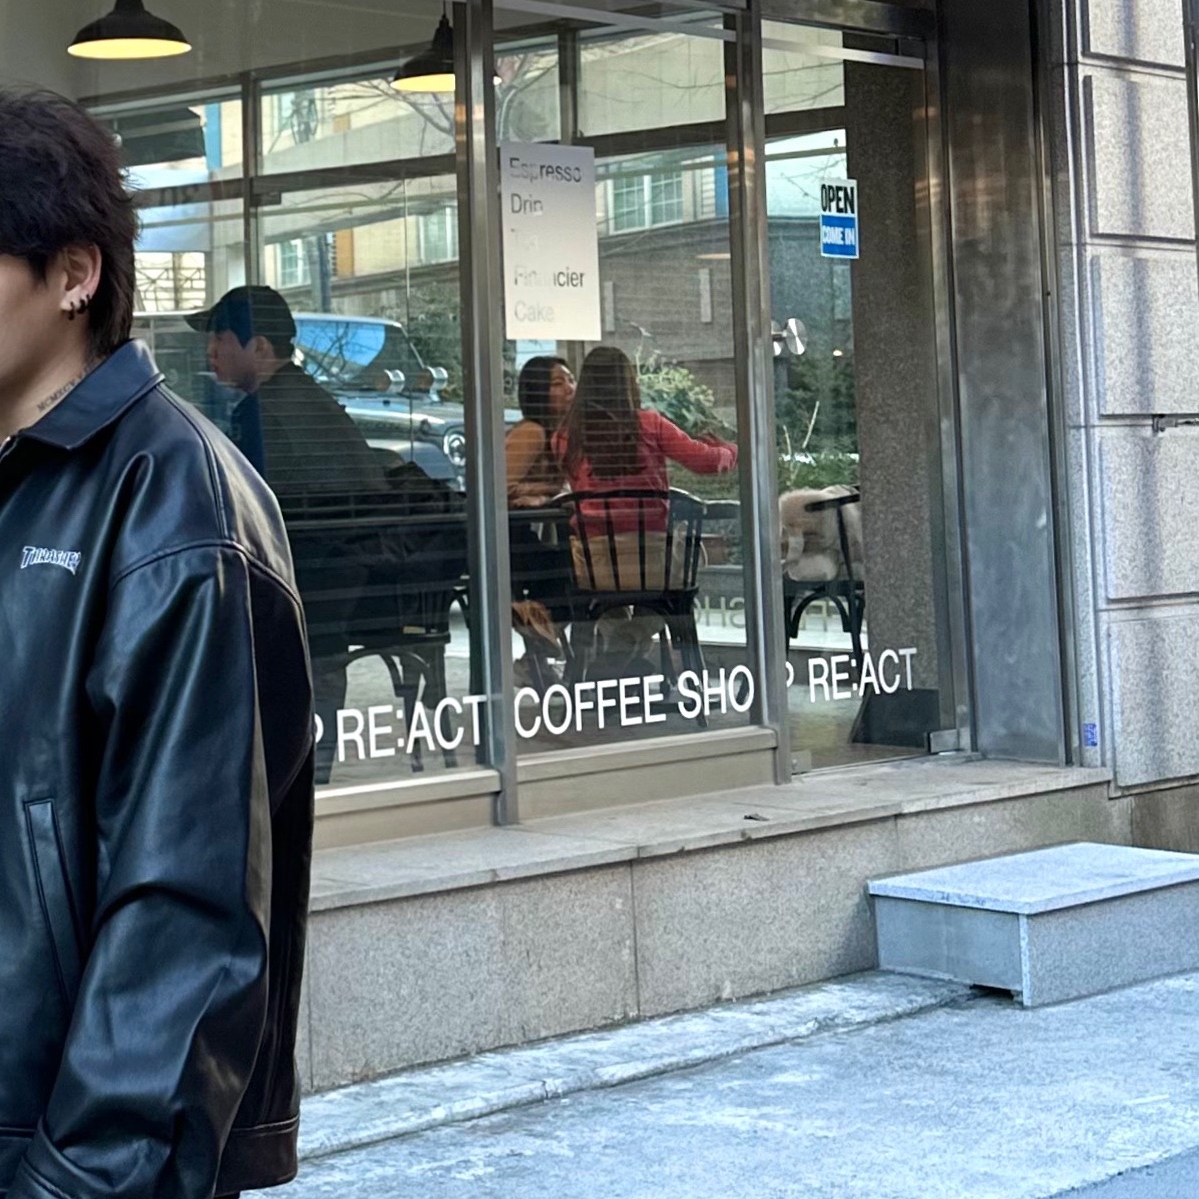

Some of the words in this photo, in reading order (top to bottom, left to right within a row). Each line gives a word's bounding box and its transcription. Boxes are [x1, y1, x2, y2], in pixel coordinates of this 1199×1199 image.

[509, 157, 582, 183] Espresso
[821, 184, 855, 214] OPEN
[845, 228, 856, 246] IN
[514, 299, 555, 323] Cake
[807, 647, 918, 703] RE:ACT
[514, 675, 667, 738] COFFEE
[336, 694, 488, 762] RE:ACT
